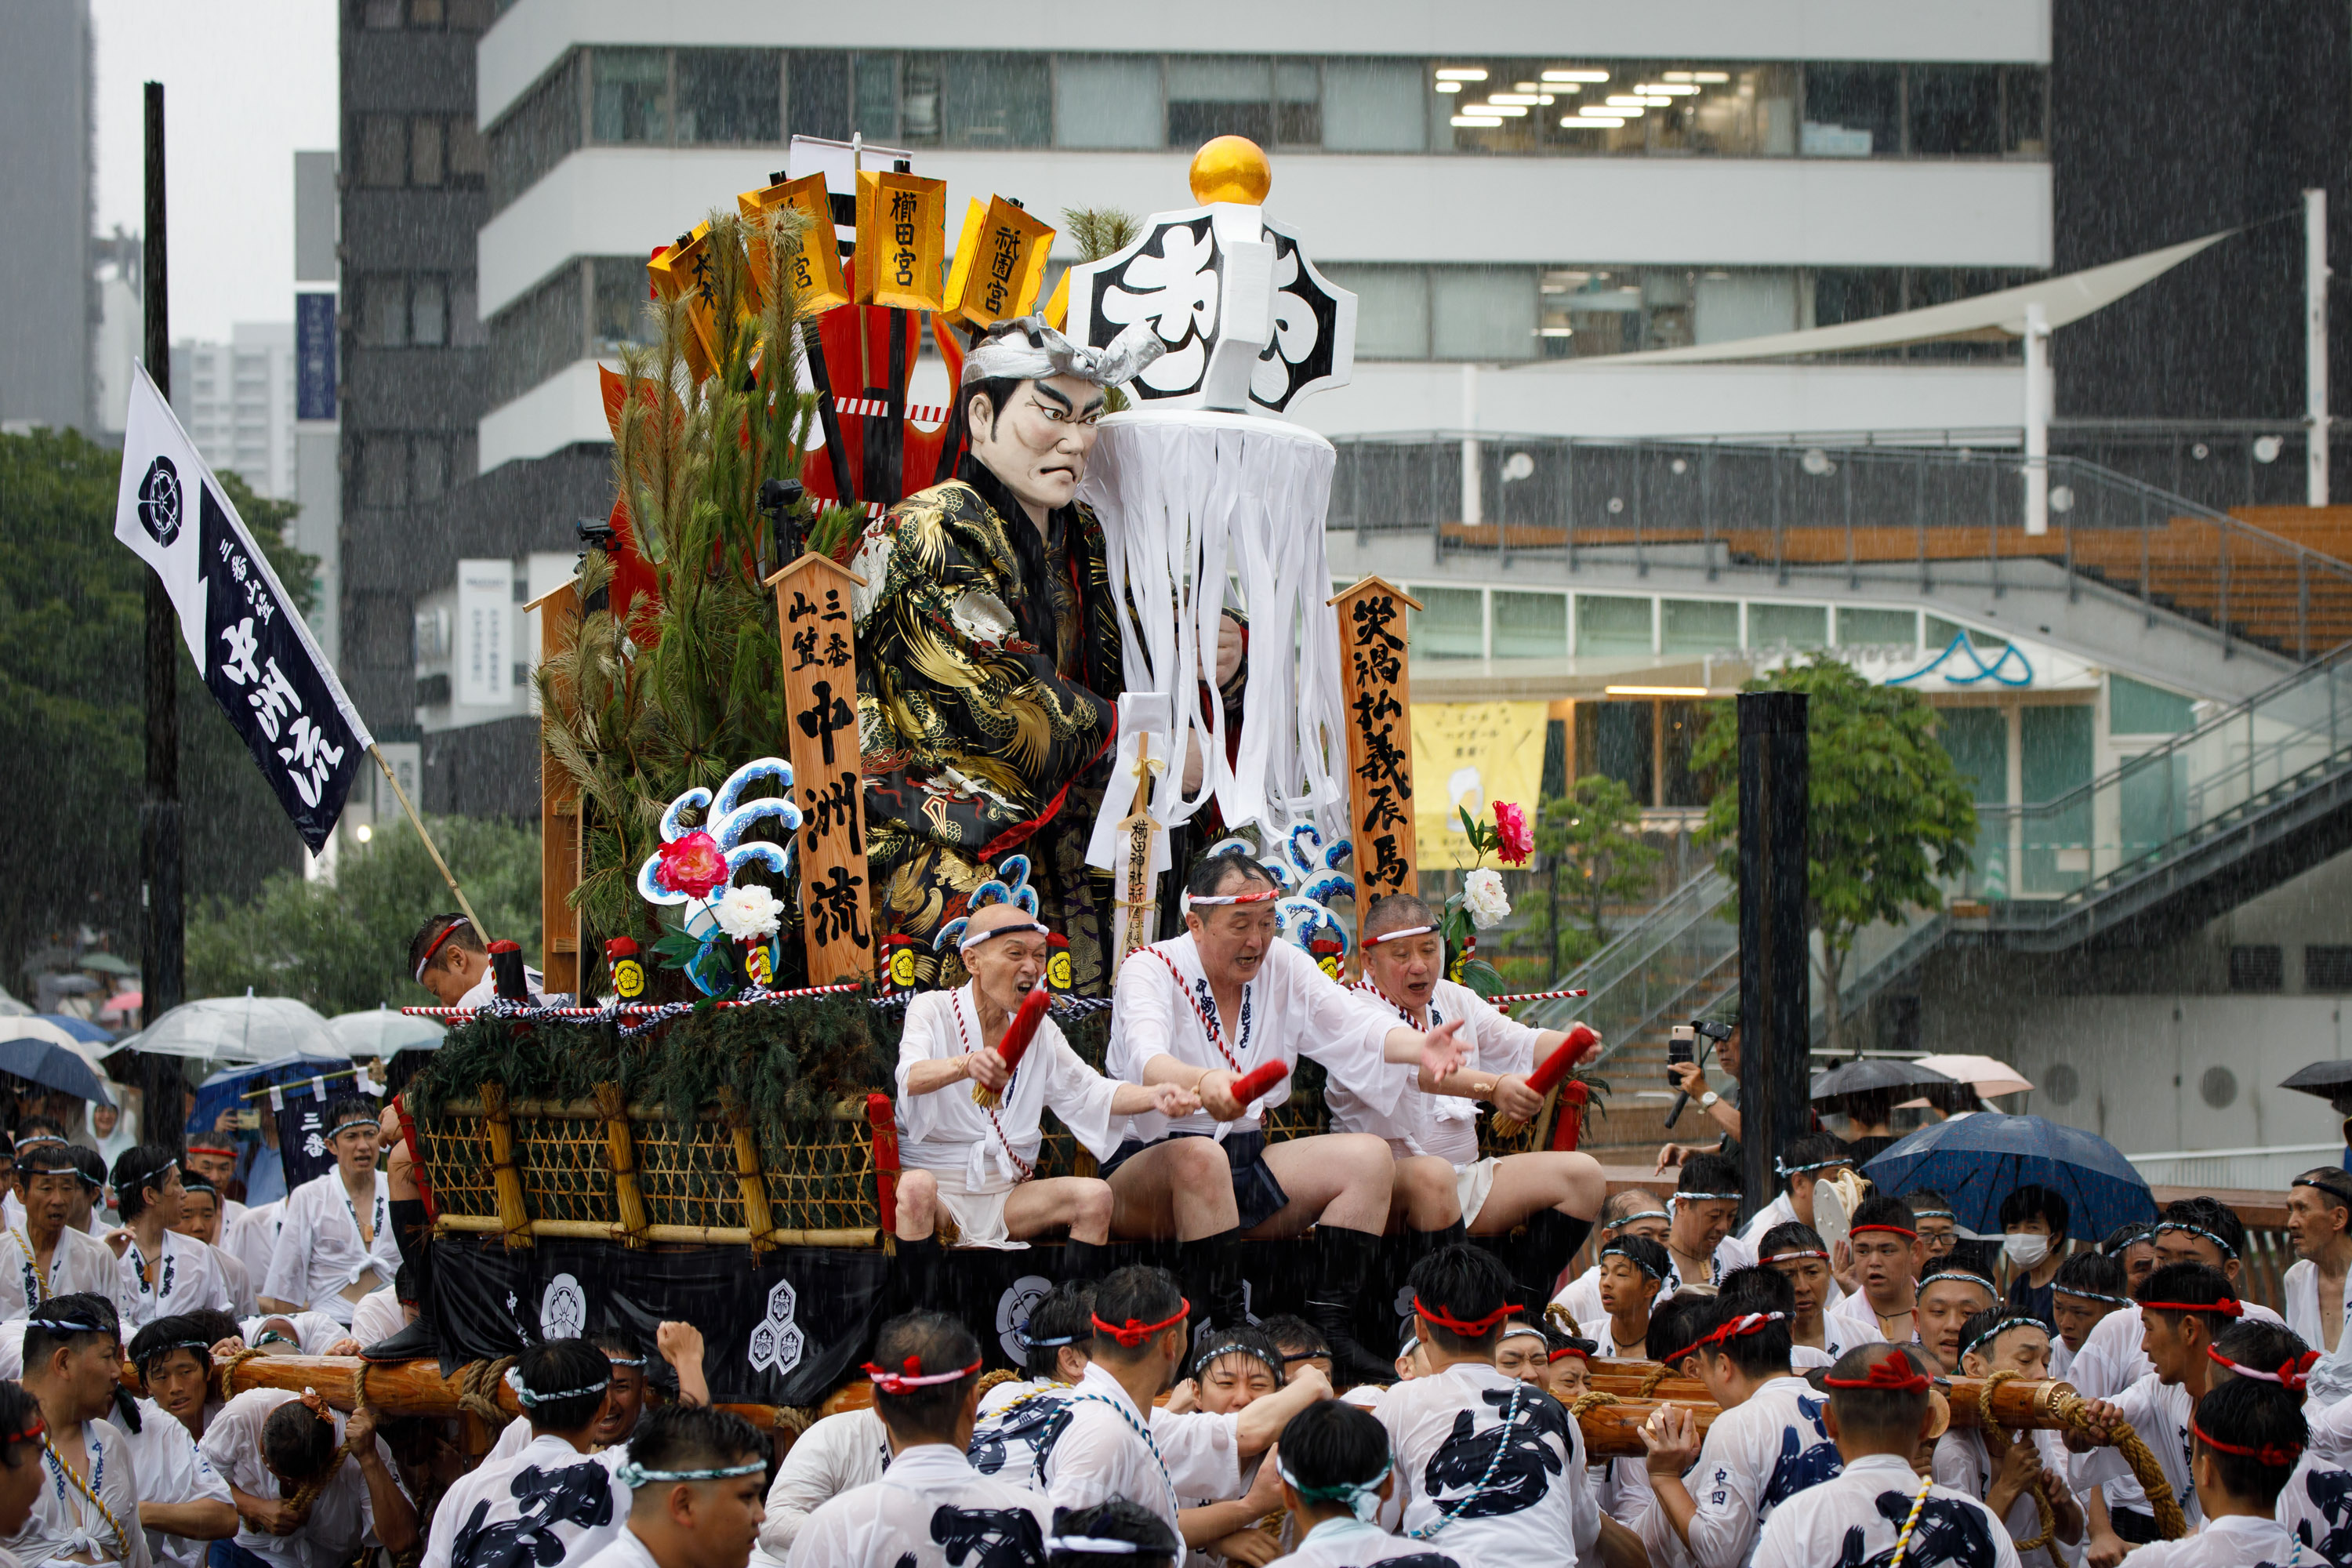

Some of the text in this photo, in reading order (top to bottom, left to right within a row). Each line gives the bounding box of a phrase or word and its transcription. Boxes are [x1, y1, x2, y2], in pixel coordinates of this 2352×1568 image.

[890, 191, 917, 287] 櫛田宮
[985, 226, 1021, 316] 祇園宮
[219, 538, 275, 626] 三番山笠
[788, 590, 825, 673] 山笠
[820, 589, 853, 669] 三番
[220, 616, 345, 808] 中洲流
[1352, 596, 1412, 906] 災禍払義辰馬
[797, 681, 870, 950] 中洲流
[300, 1112, 328, 1158] 三番
[1711, 1468, 1728, 1506] 中四
